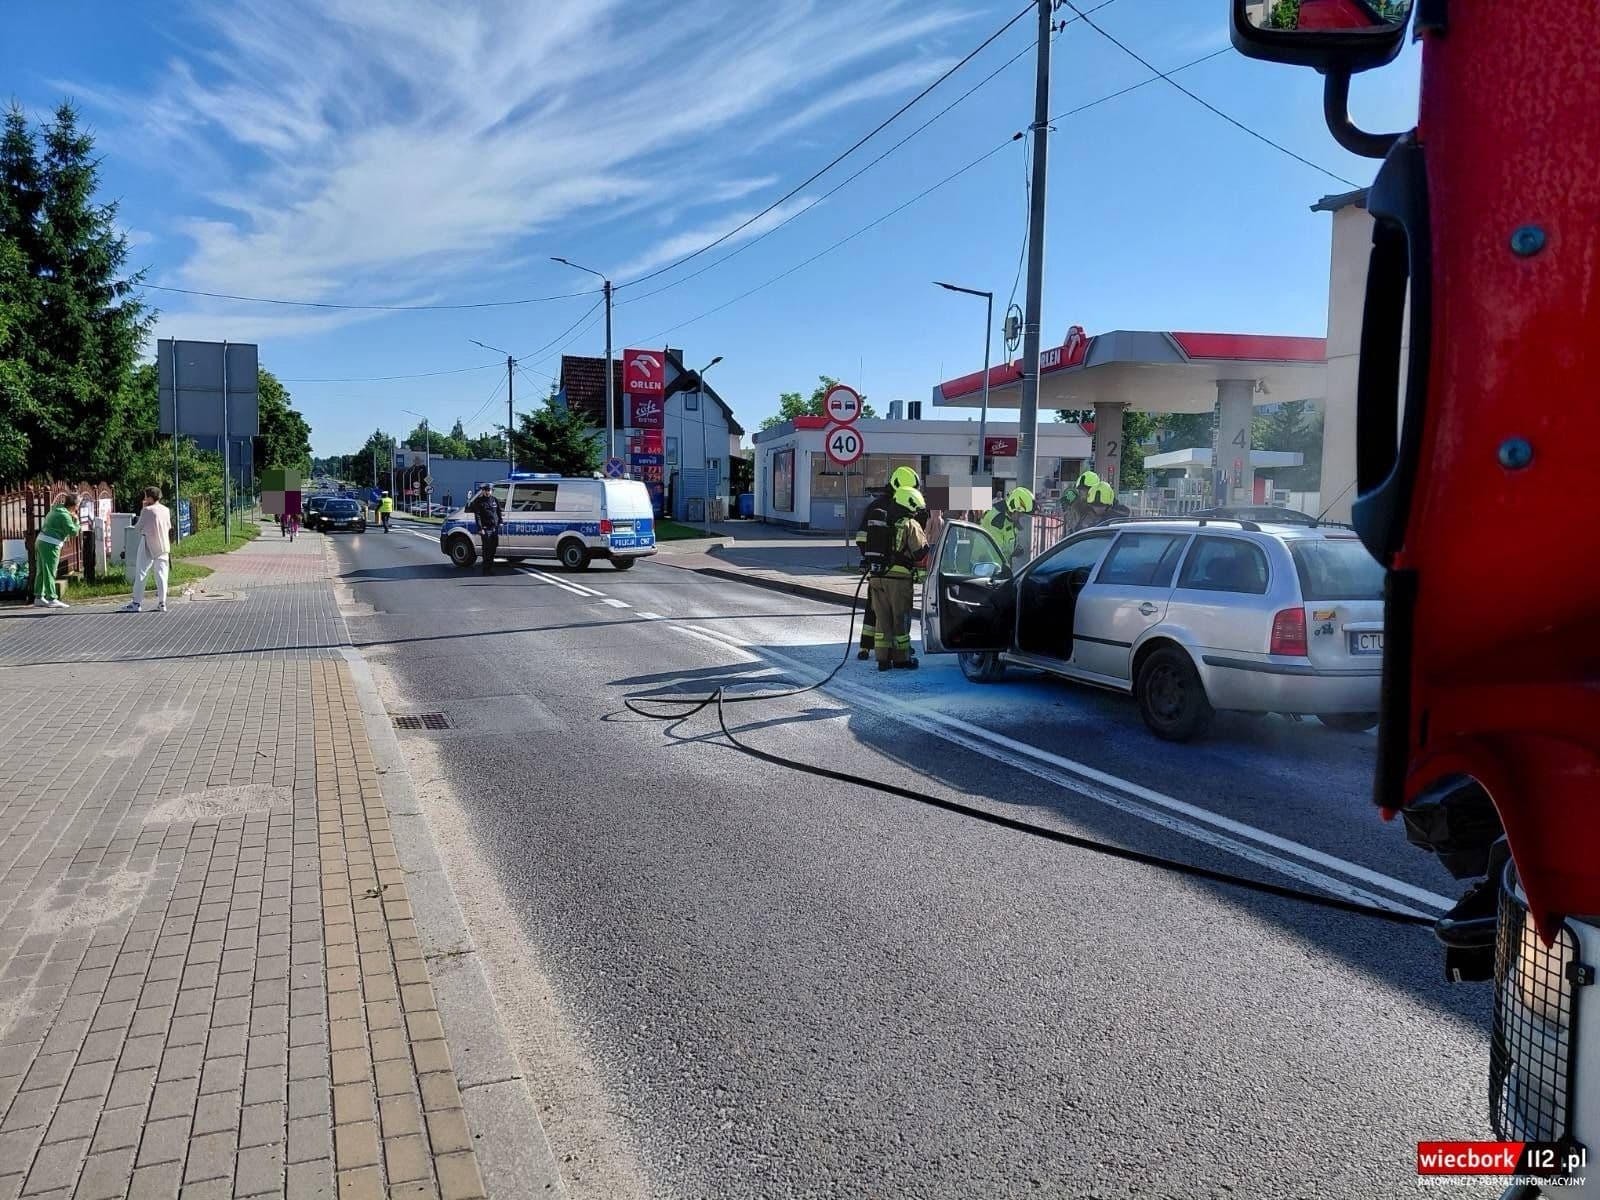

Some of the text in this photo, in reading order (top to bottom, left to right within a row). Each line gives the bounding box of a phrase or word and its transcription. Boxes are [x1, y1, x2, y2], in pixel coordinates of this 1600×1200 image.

[1040, 348, 1061, 369] RLEN
[630, 380, 662, 390] ORLEN
[832, 435, 857, 453] 40
[1232, 428, 1246, 449] 4
[1106, 441, 1119, 457] 2
[515, 523, 544, 533] POLICJA
